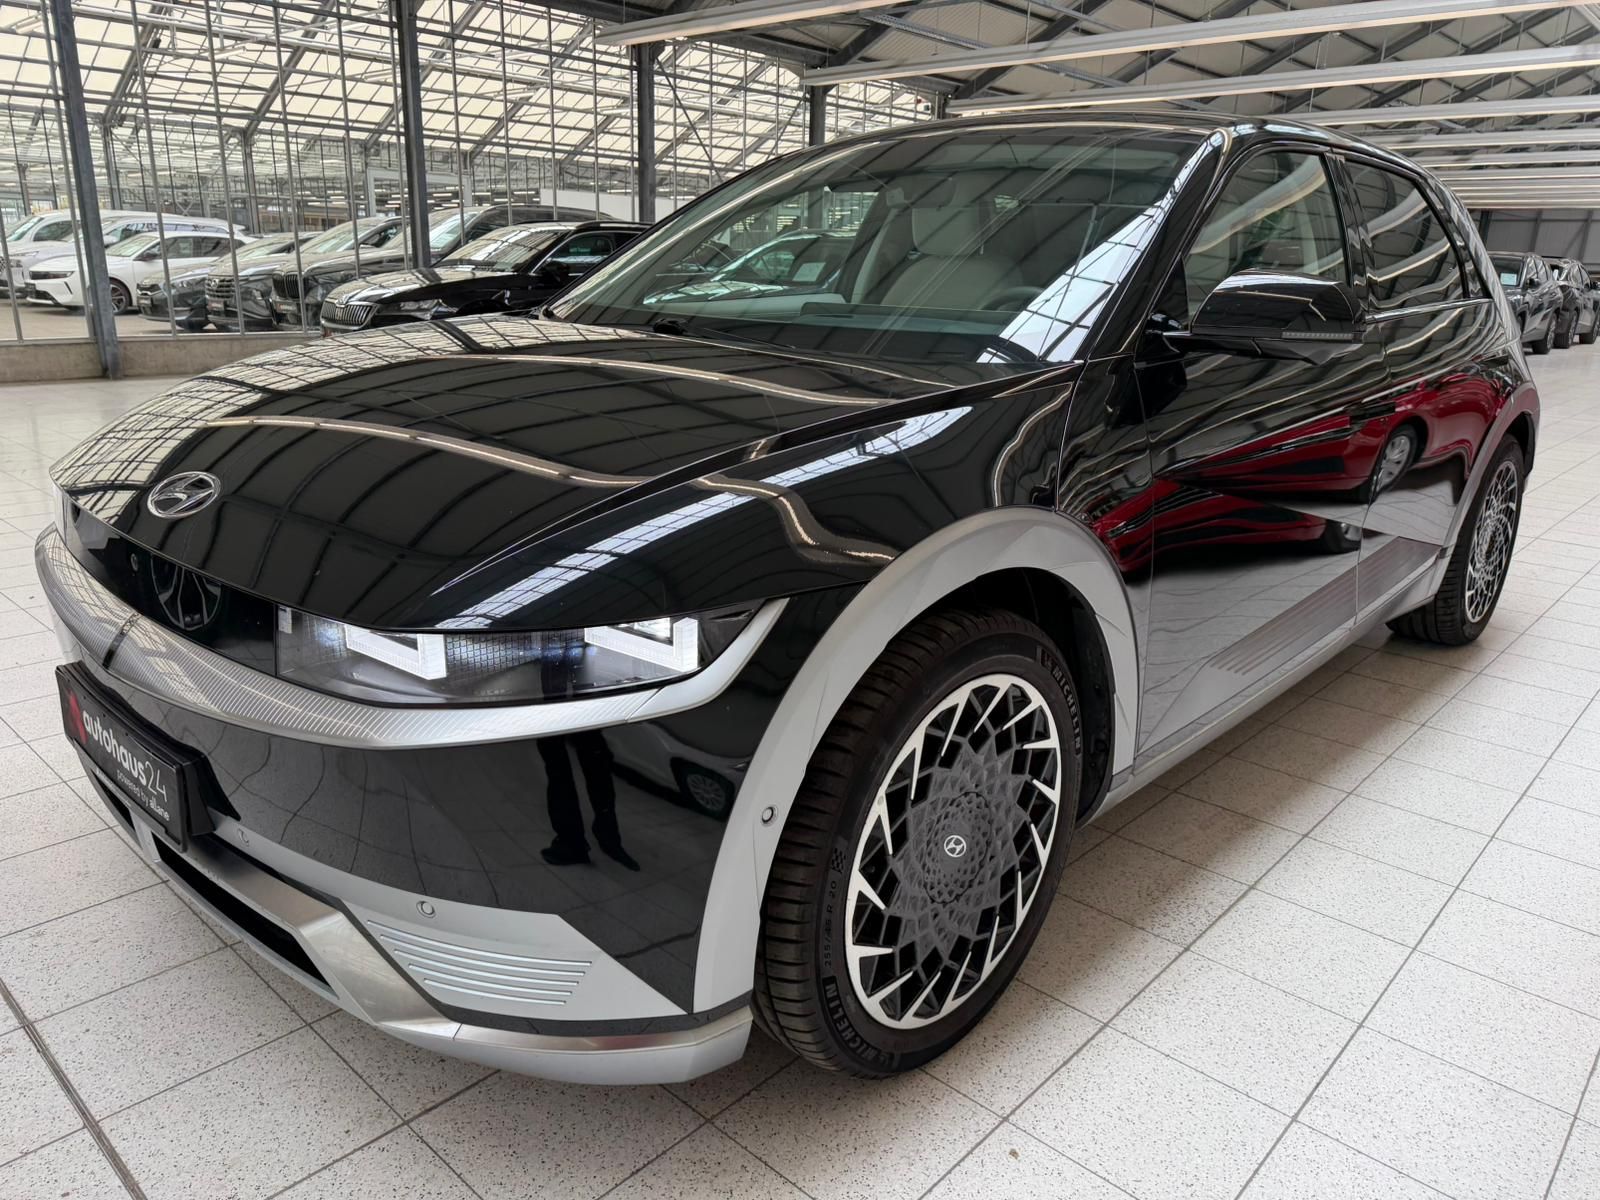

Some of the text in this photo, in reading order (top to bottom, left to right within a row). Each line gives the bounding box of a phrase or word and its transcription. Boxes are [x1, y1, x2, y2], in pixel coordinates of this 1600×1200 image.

[1052, 666, 1081, 748] MICHELIN
[83, 710, 167, 802] autohaus24
[825, 983, 878, 1060] MICHELIN
